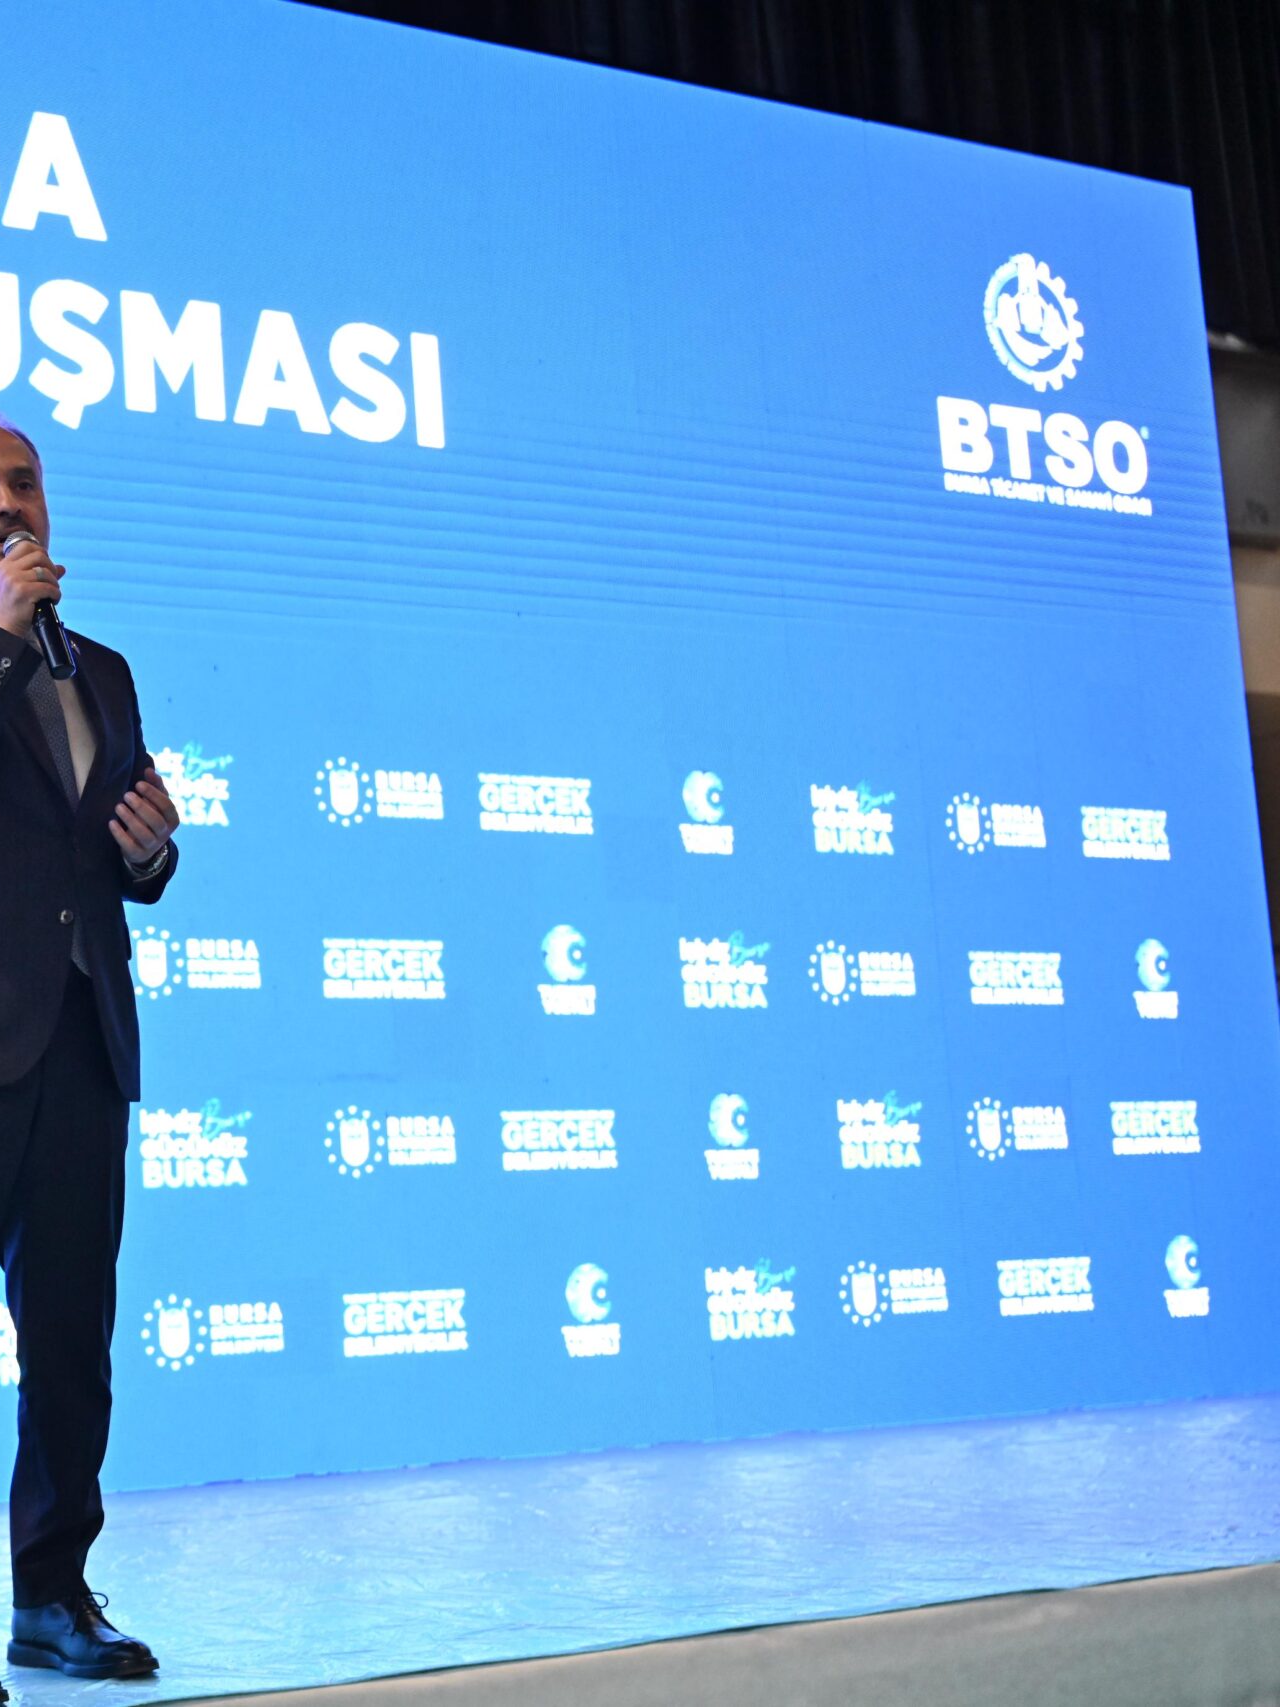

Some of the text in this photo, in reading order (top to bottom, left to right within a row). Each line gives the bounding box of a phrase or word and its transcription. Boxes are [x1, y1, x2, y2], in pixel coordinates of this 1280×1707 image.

[937, 396, 1148, 494] BTSO
[480, 784, 591, 815] GERÇEK
[324, 949, 444, 982] GERÇEK
[502, 1120, 616, 1151] GERÇEK
[142, 1158, 249, 1189] BURSA
[344, 1299, 466, 1335] GERÇEK
